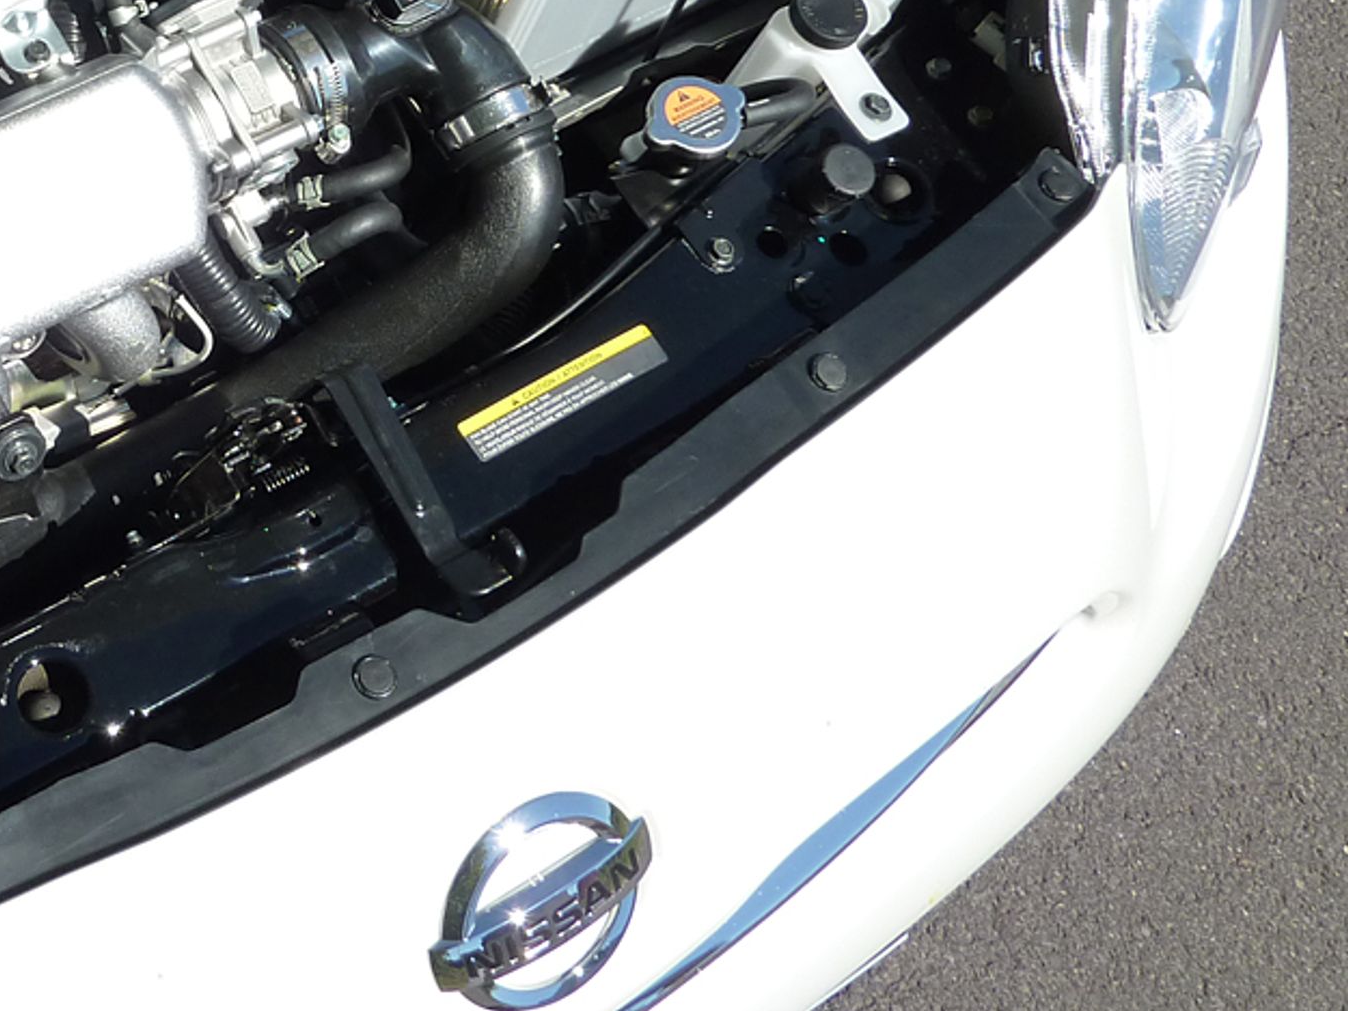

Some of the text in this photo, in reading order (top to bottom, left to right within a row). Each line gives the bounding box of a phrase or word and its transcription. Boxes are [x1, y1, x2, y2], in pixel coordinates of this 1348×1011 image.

[522, 379, 556, 399] CAUTION
[562, 353, 603, 376] ATTENTION
[464, 849, 642, 978] NISSAN
